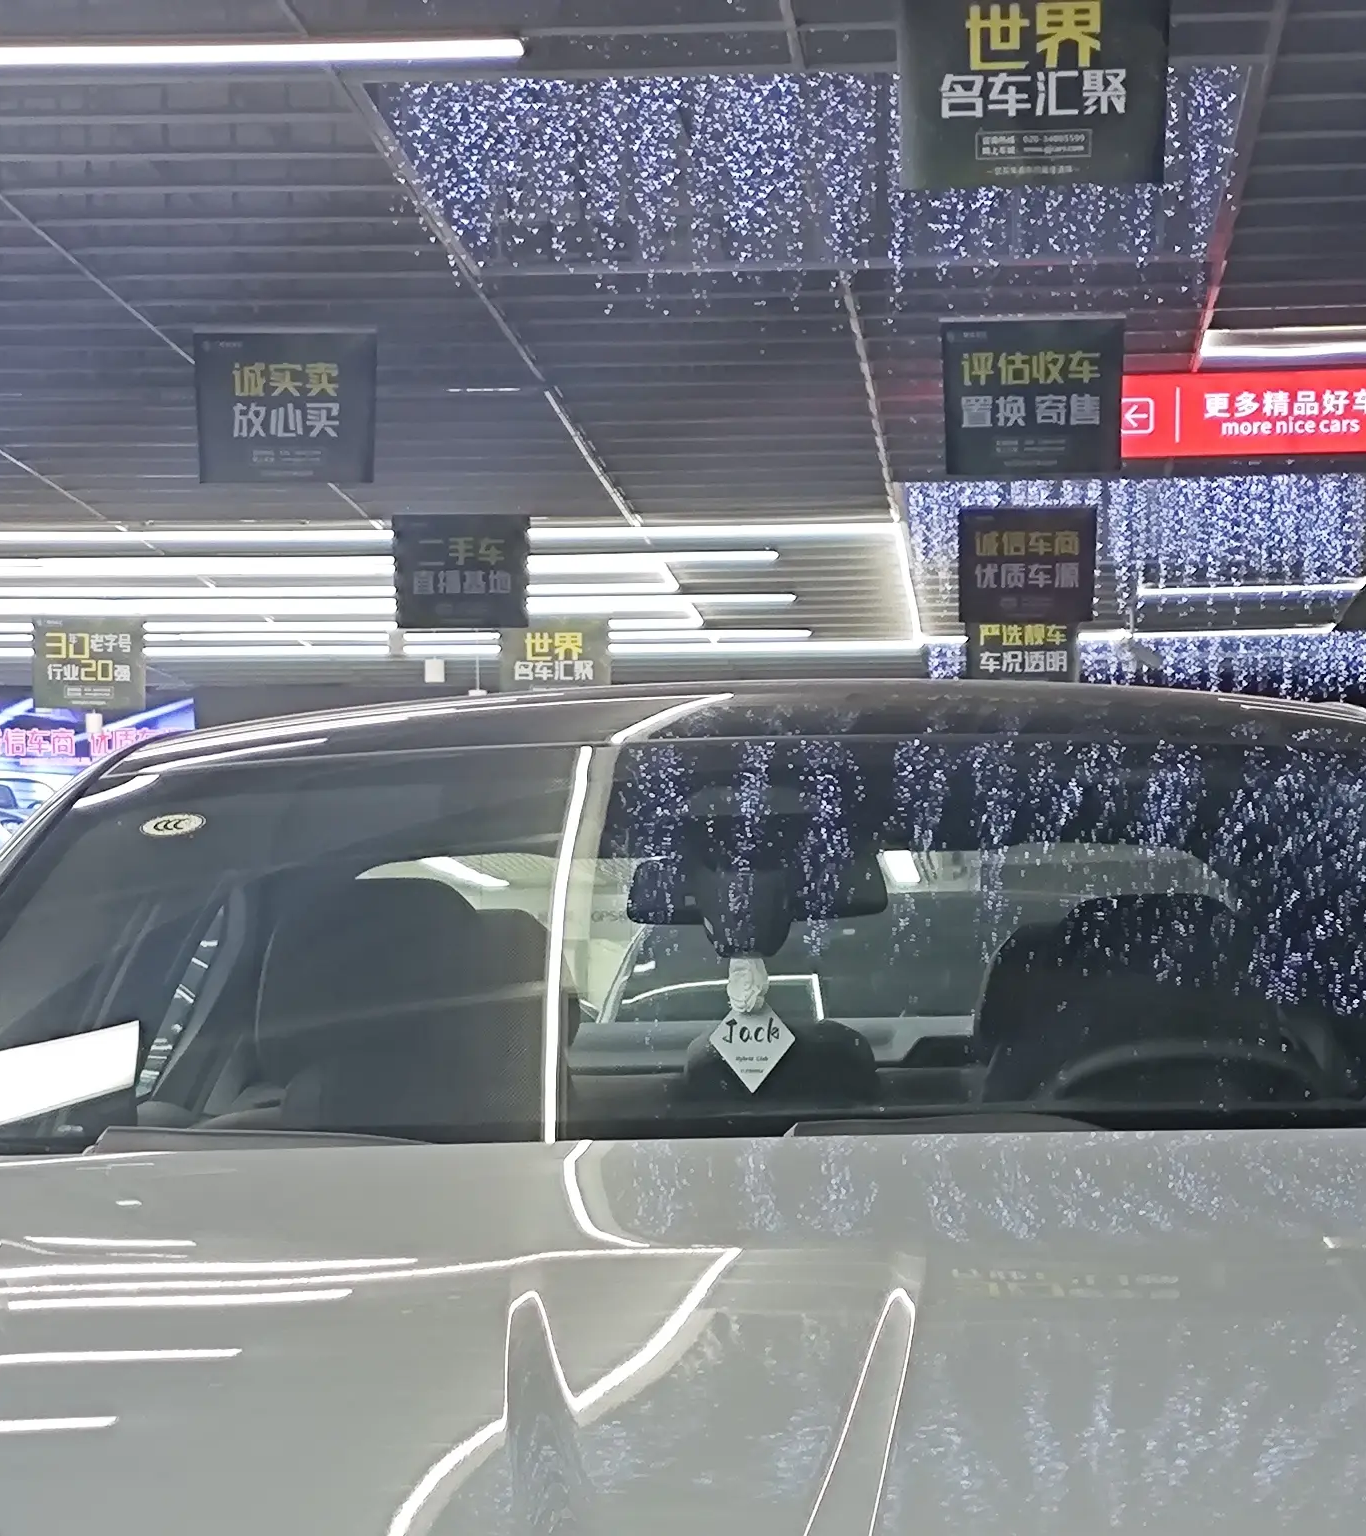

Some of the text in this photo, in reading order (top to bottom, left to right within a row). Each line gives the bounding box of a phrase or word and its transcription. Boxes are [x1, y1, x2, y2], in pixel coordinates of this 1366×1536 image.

[965, 1, 1101, 70] 世界
[940, 69, 1126, 119] 名车汇聚
[232, 362, 339, 397] 诚实卖
[961, 350, 1101, 386] 评估收车
[232, 402, 339, 438] 放心买
[961, 394, 1101, 428] 置换寄售
[1221, 416, 1360, 436] more nice cars
[418, 537, 505, 566] 二手车
[974, 531, 1080, 556] 诚信车商
[974, 563, 1080, 588] 优质车源
[525, 632, 583, 661] 世界
[979, 624, 1068, 646] 严选靓车
[47, 659, 131, 682] 行业20强
[514, 660, 594, 681] 名车汇聚
[979, 651, 1068, 673] 车况透明
[722, 1017, 780, 1044] Jack
